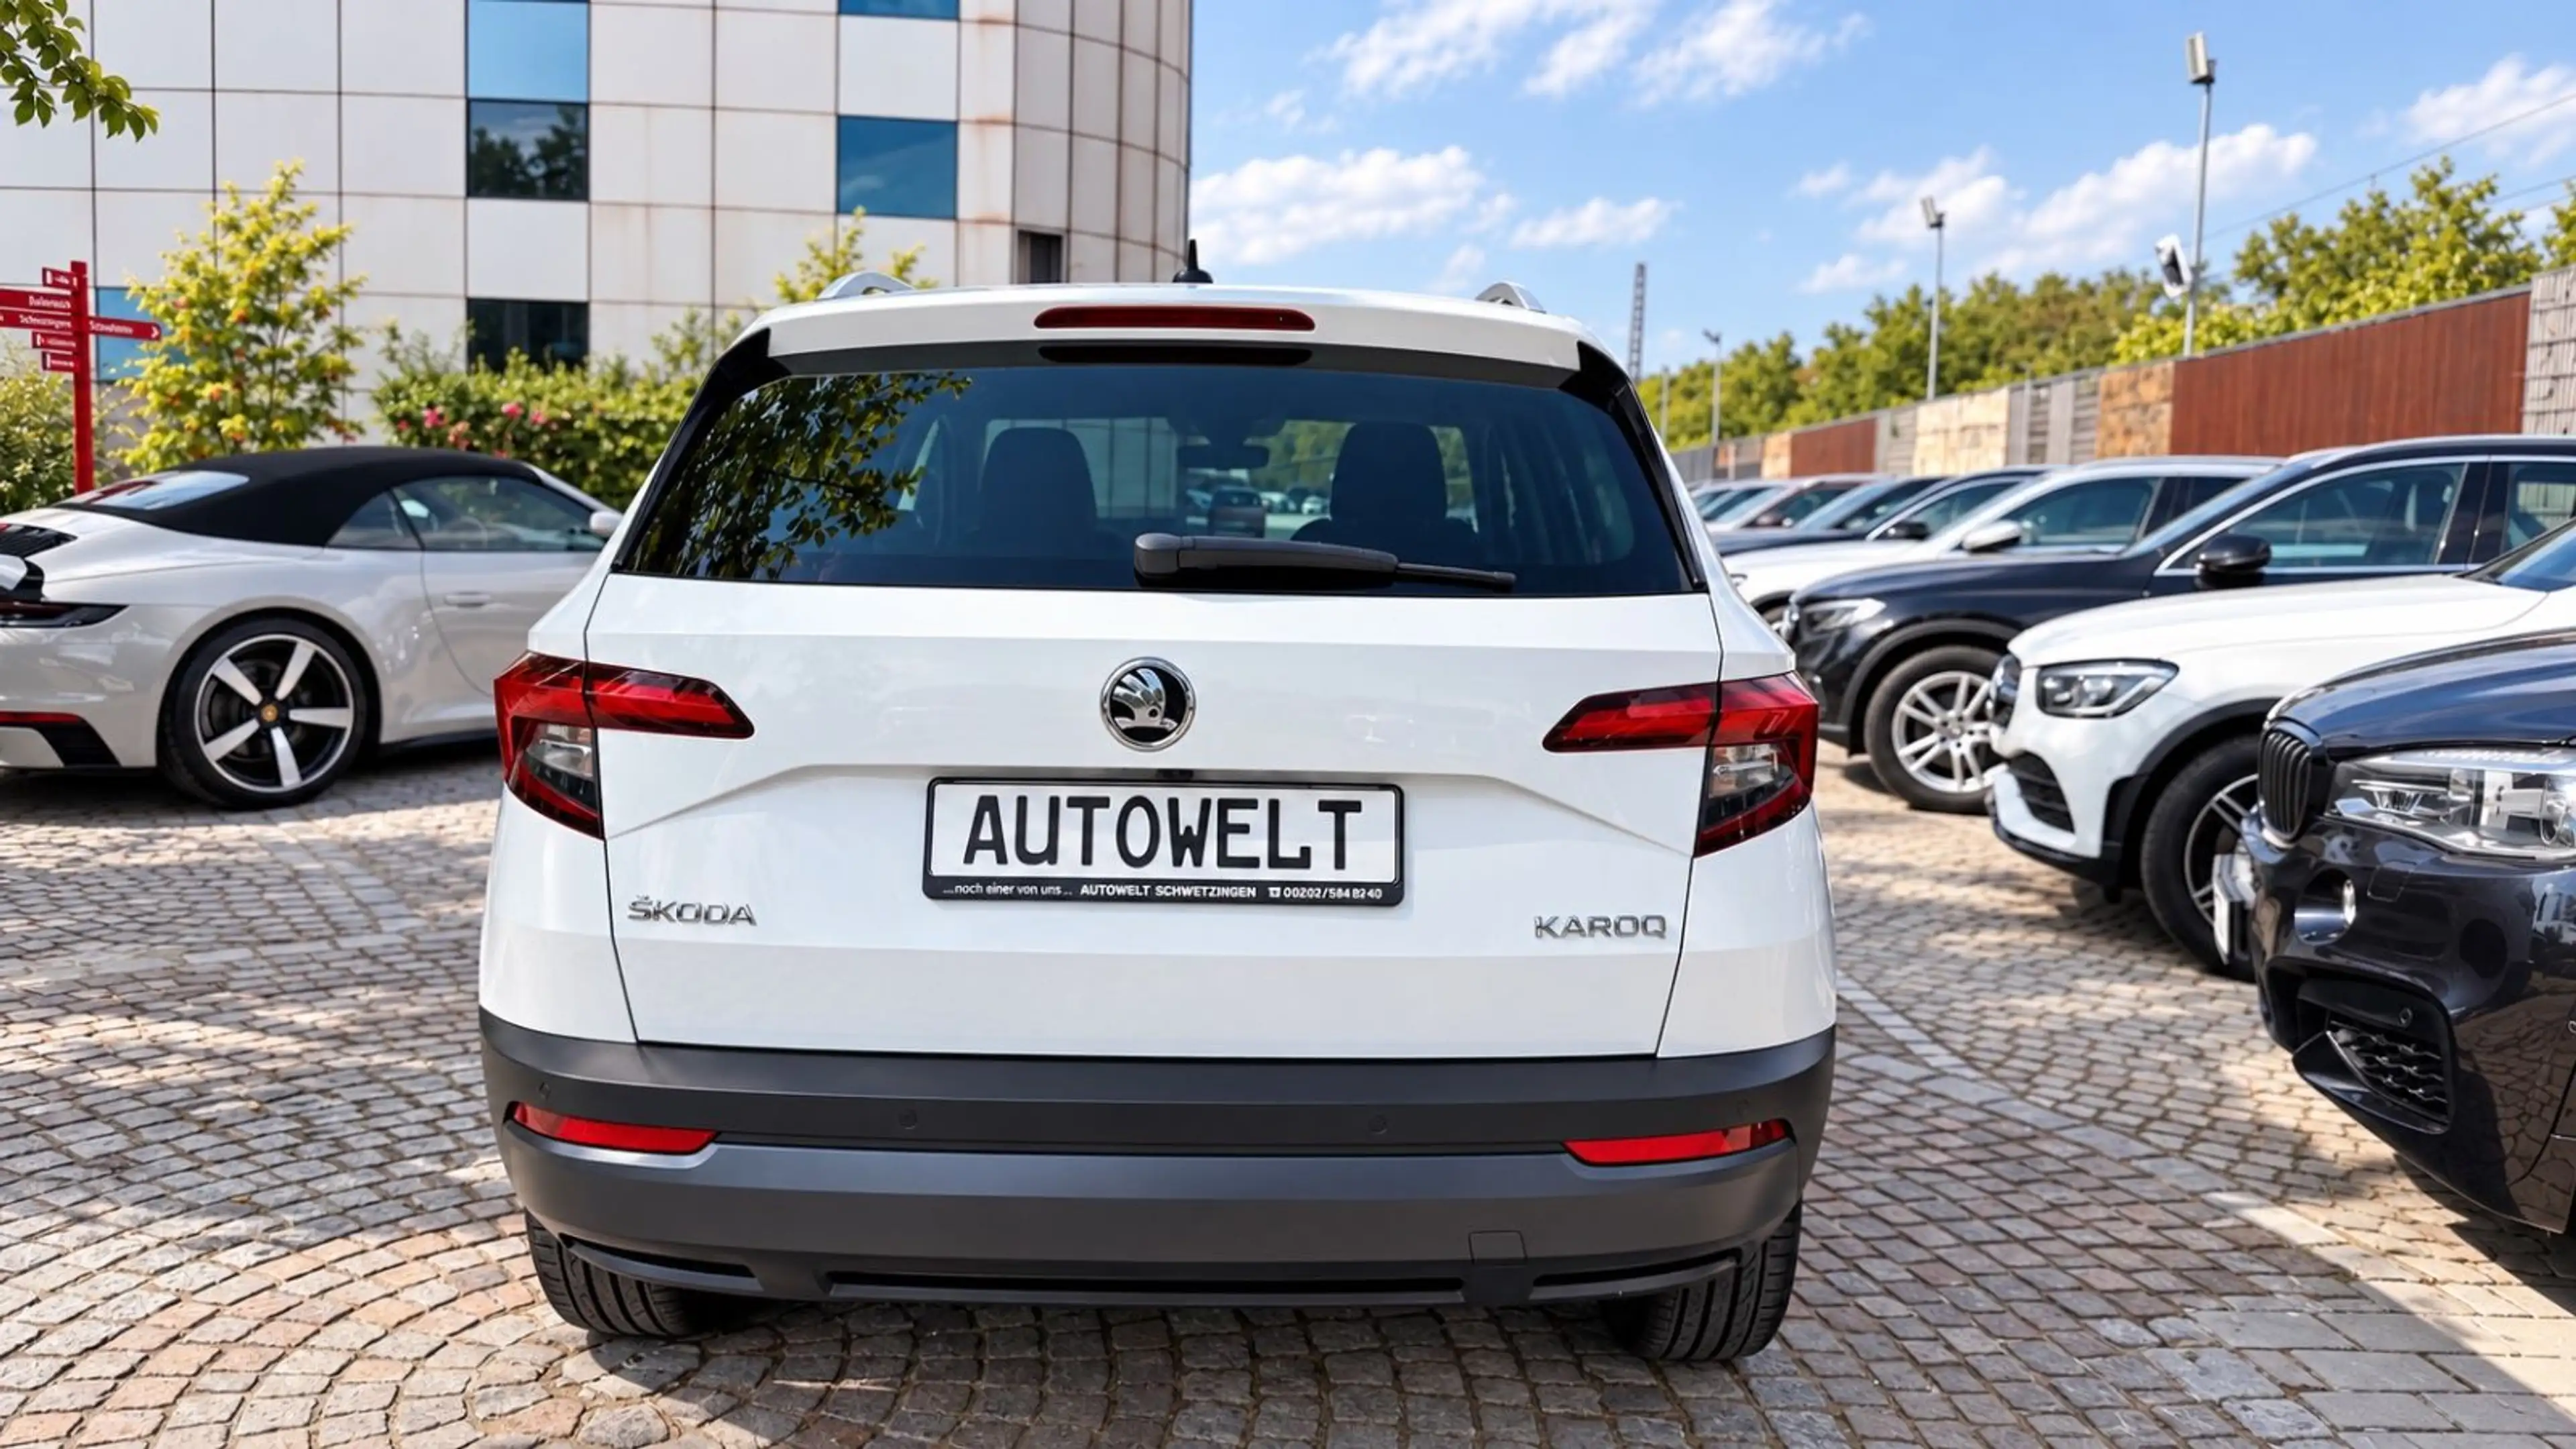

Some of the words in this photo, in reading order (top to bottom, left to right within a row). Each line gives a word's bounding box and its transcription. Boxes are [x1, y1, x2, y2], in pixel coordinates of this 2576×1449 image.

[964, 795, 1362, 870] AUTOWELT
[985, 882, 1015, 895] einer
[1016, 885, 1038, 896] von
[1079, 884, 1152, 897] AUTOWELT
[1155, 885, 1257, 898] SCHWETZINGEN
[628, 895, 757, 926] ŠKODA
[1534, 914, 1666, 939] KAROQ
